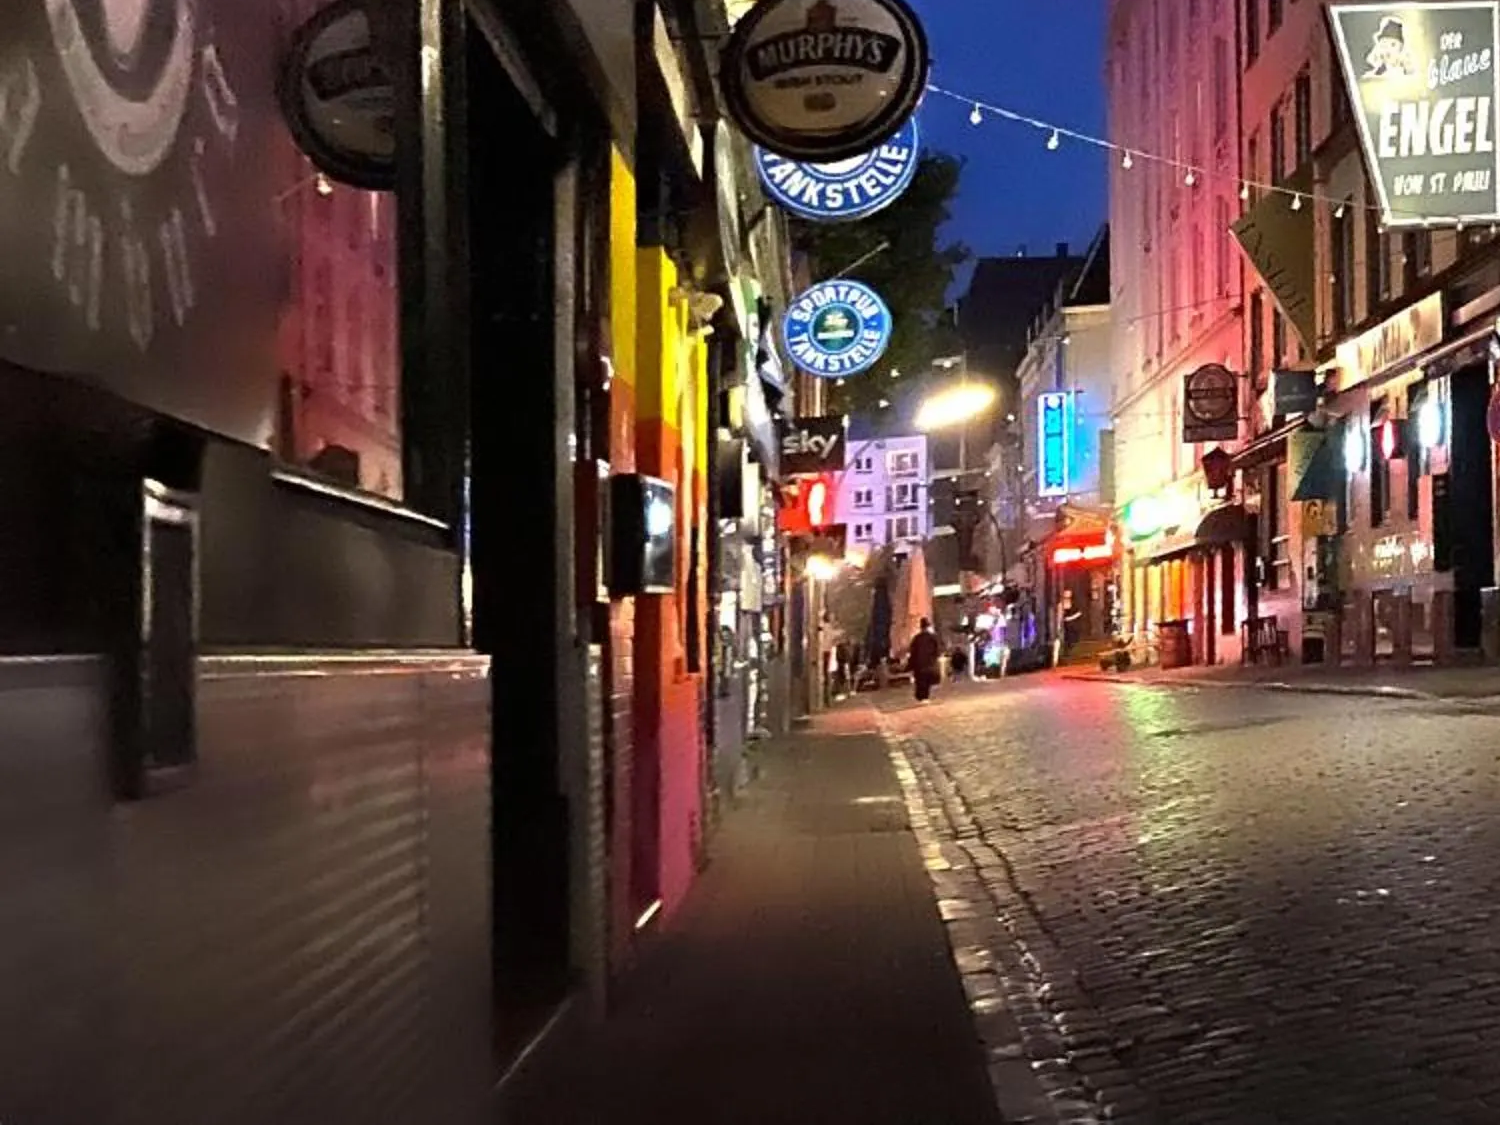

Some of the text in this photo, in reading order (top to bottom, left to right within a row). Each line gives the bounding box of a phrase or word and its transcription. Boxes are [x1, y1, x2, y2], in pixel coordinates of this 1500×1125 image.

[1378, 96, 1493, 158] ENGEL
[789, 328, 881, 371] TANKSTELLE
[782, 430, 838, 459] sky
